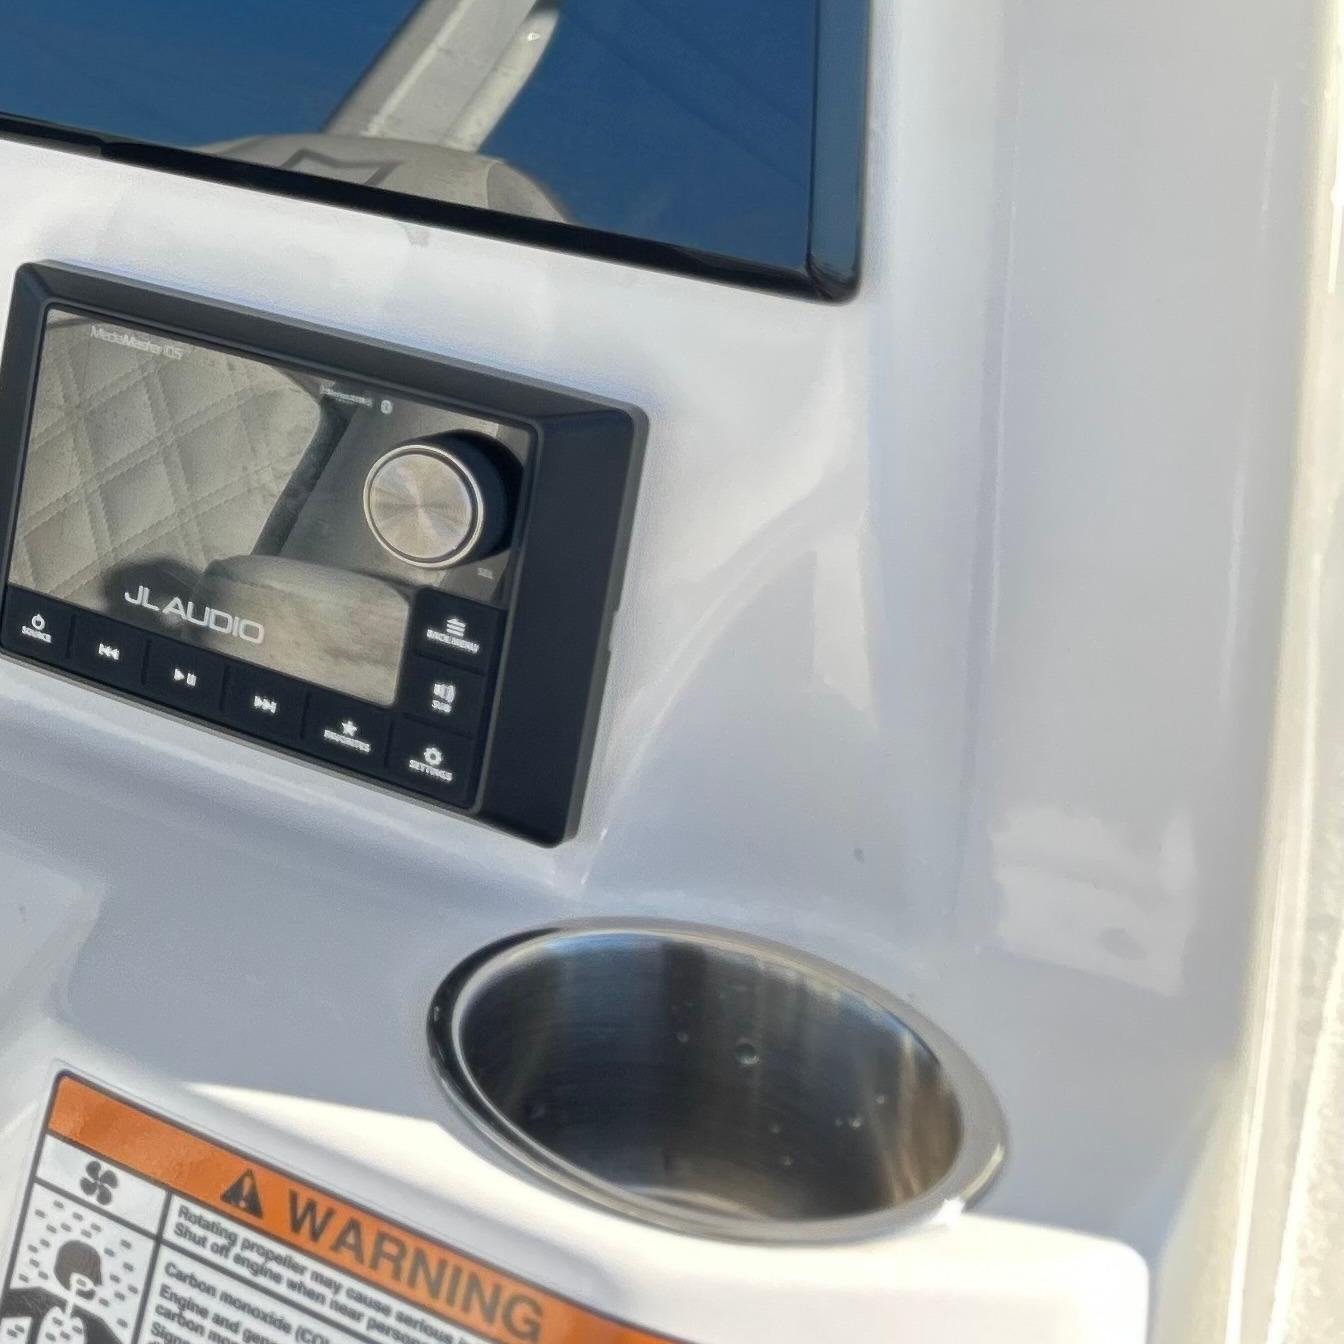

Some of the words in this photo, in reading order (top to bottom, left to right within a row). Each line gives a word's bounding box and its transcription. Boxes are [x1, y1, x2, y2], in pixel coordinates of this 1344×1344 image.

[124, 585, 160, 611] JL
[162, 596, 265, 644] AUDIO
[164, 1261, 217, 1299] Carbon
[219, 1289, 293, 1335] monoxide
[174, 1222, 208, 1249] Shut
[210, 1241, 232, 1260] off
[232, 1253, 284, 1285] engine
[286, 1276, 327, 1306] when
[329, 1297, 365, 1323] near
[177, 1205, 239, 1245] Rotating
[239, 1238, 308, 1275] propeller
[309, 1269, 343, 1297] may
[345, 1286, 392, 1316] cause
[395, 1310, 455, 1344] serious
[287, 1190, 545, 1343] WARNING
[155, 1303, 206, 1337] carbon
[159, 1283, 210, 1320] Engine
[212, 1312, 241, 1335] and
